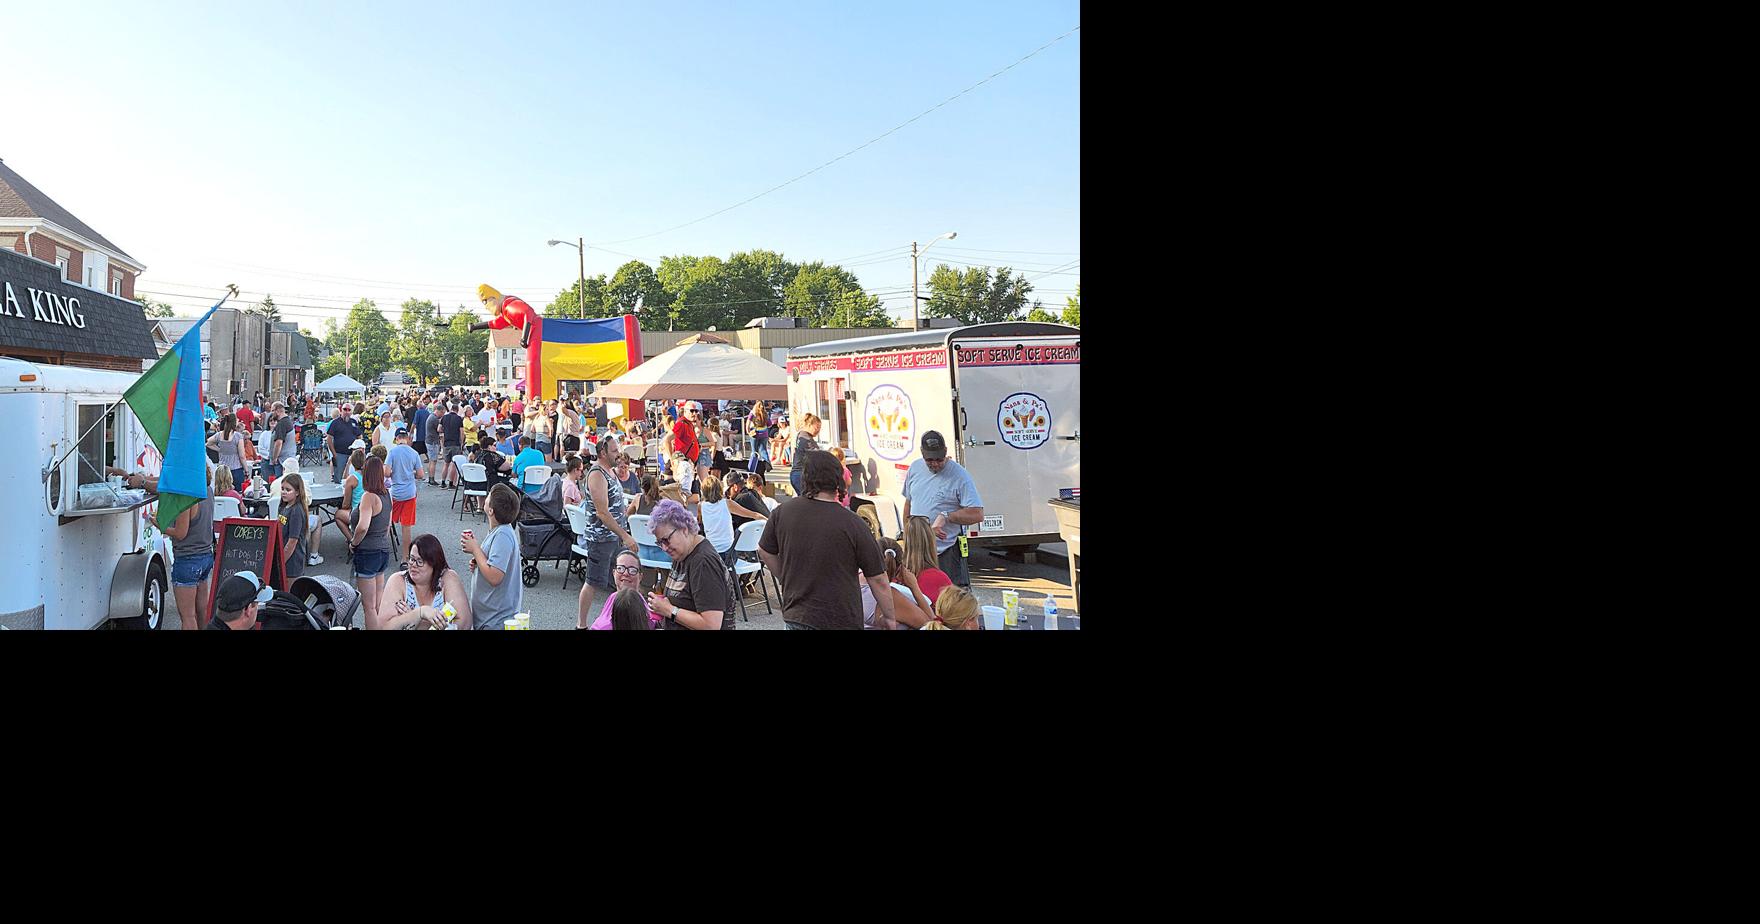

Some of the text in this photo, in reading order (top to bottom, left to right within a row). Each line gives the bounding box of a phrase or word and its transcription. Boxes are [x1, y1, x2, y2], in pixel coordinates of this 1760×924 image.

[0, 281, 86, 329] A KING
[855, 351, 946, 370] SOFT SERVE ICE CREAM
[958, 347, 1080, 363] SOFT SERVE ICE CREAM
[1011, 434, 1021, 442] ICE
